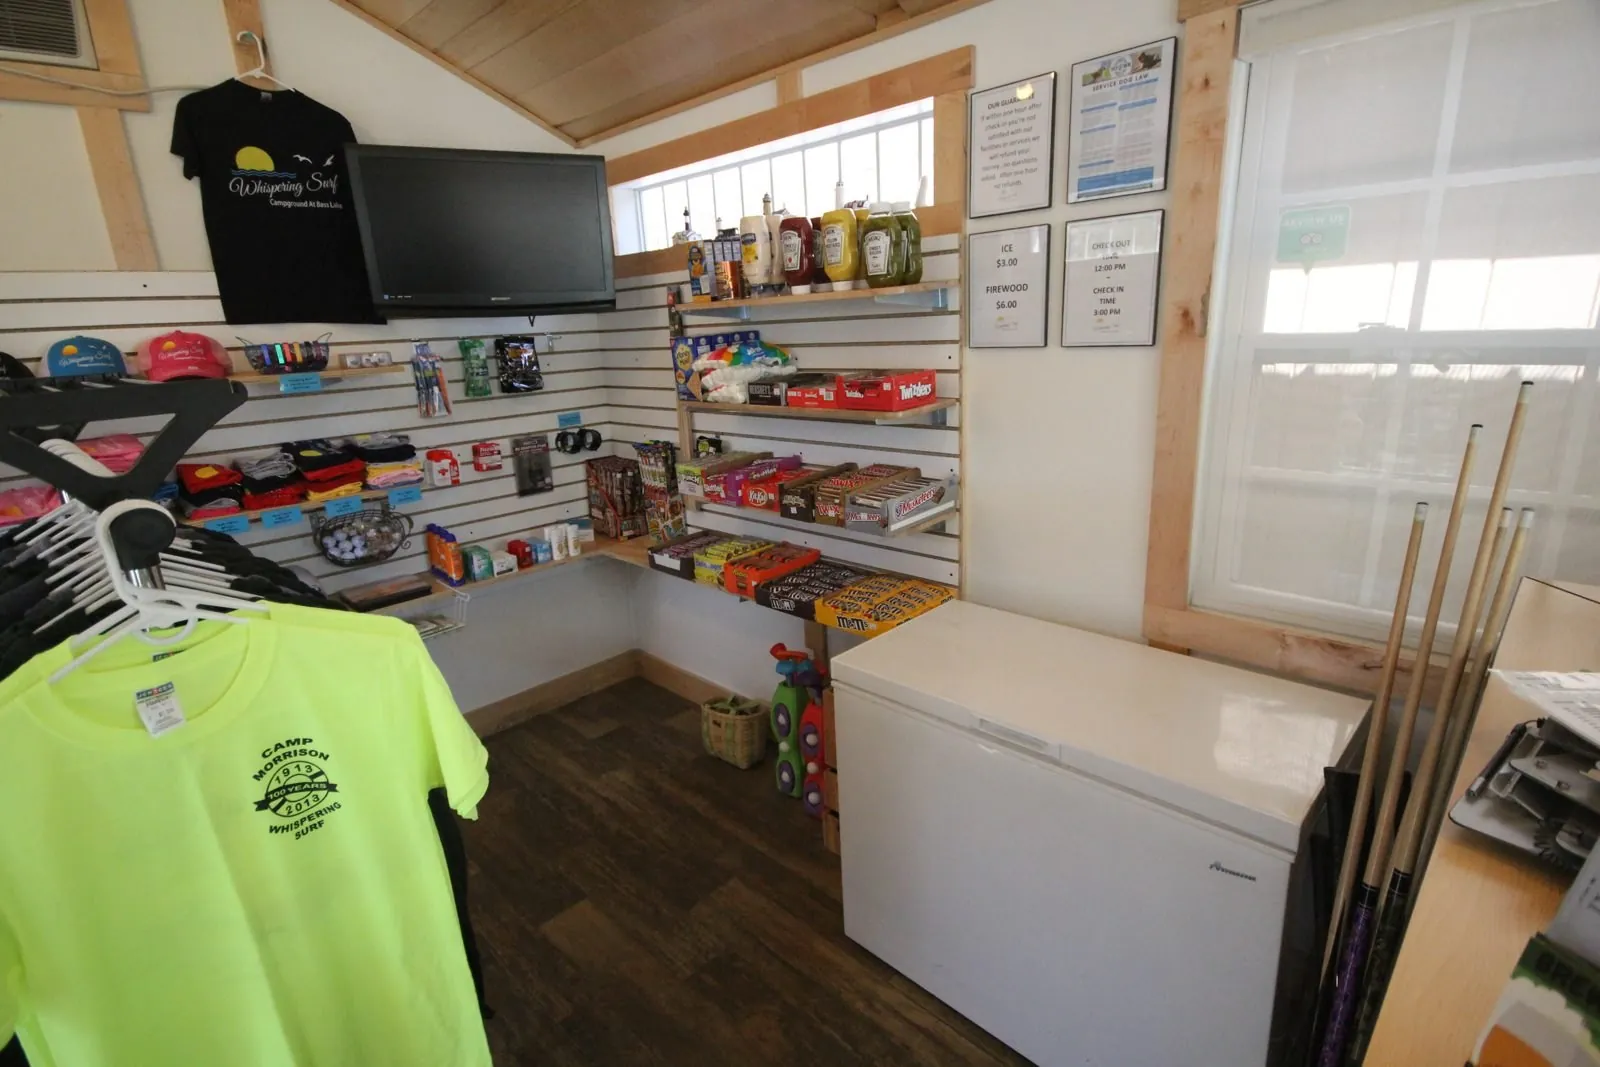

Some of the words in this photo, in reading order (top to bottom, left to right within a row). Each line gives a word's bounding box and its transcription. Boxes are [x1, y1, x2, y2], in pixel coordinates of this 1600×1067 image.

[1135, 72, 1149, 81] LAW
[229, 177, 304, 198] Whispering
[306, 172, 338, 194] Surf
[269, 199, 308, 209] Campground
[1001, 244, 1014, 253] ICE
[1115, 239, 1131, 248] OUT
[996, 258, 1018, 268] $3.00
[1095, 264, 1113, 273] 12:00
[1114, 263, 1126, 271] PM
[986, 283, 1028, 294] FIREWOOD
[1093, 286, 1115, 295] CHECK
[1116, 285, 1124, 293] IN
[996, 300, 1017, 310] $6.00
[1100, 297, 1116, 305] TIME
[1094, 308, 1108, 316] 3:00
[1109, 307, 1121, 315] PM
[899, 382, 932, 400] Twizzlers
[902, 486, 937, 514] Musketeers
[262, 738, 313, 759] CAMP
[252, 749, 330, 782] MORRISON
[274, 764, 313, 785] 1913
[267, 789, 286, 800] 100
[287, 783, 327, 794] YEARS
[285, 794, 320, 816] 2013
[269, 802, 342, 834] WHISPERING
[295, 820, 325, 840] SURF
